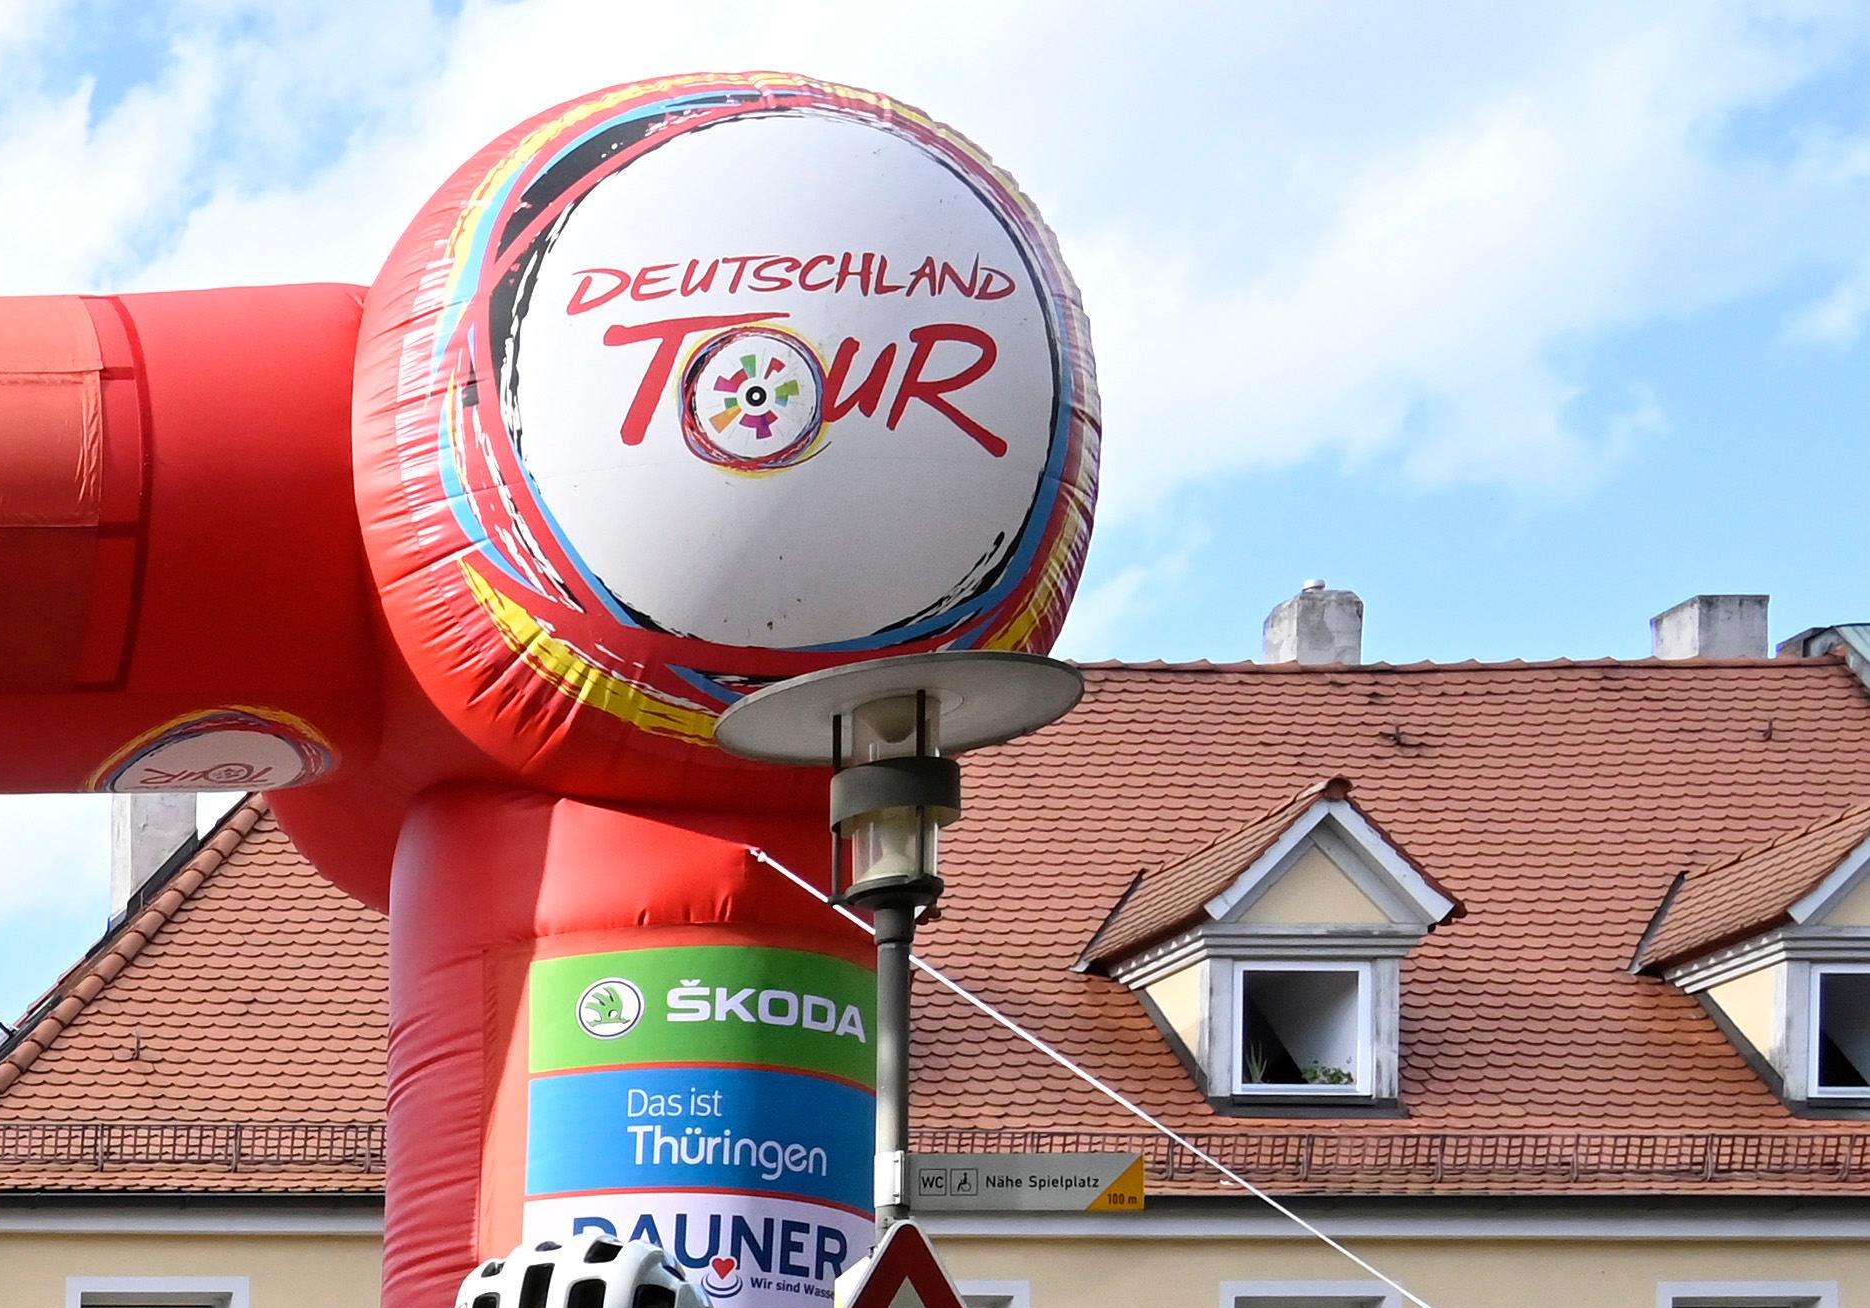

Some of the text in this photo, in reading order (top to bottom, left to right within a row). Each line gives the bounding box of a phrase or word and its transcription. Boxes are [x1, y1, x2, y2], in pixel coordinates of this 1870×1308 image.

[566, 252, 1016, 316] DEUTSCHLAND
[603, 312, 1007, 479] TOUR
[667, 979, 866, 1043] ŠKODA
[627, 1087, 722, 1117] Das ist
[627, 1125, 827, 1180] Thüringen
[922, 1176, 1099, 1190] WC Nähe Spielplatz
[1108, 1194, 1125, 1205] 100
[751, 1276, 772, 1290] Wir
[776, 1278, 800, 1293] sind
